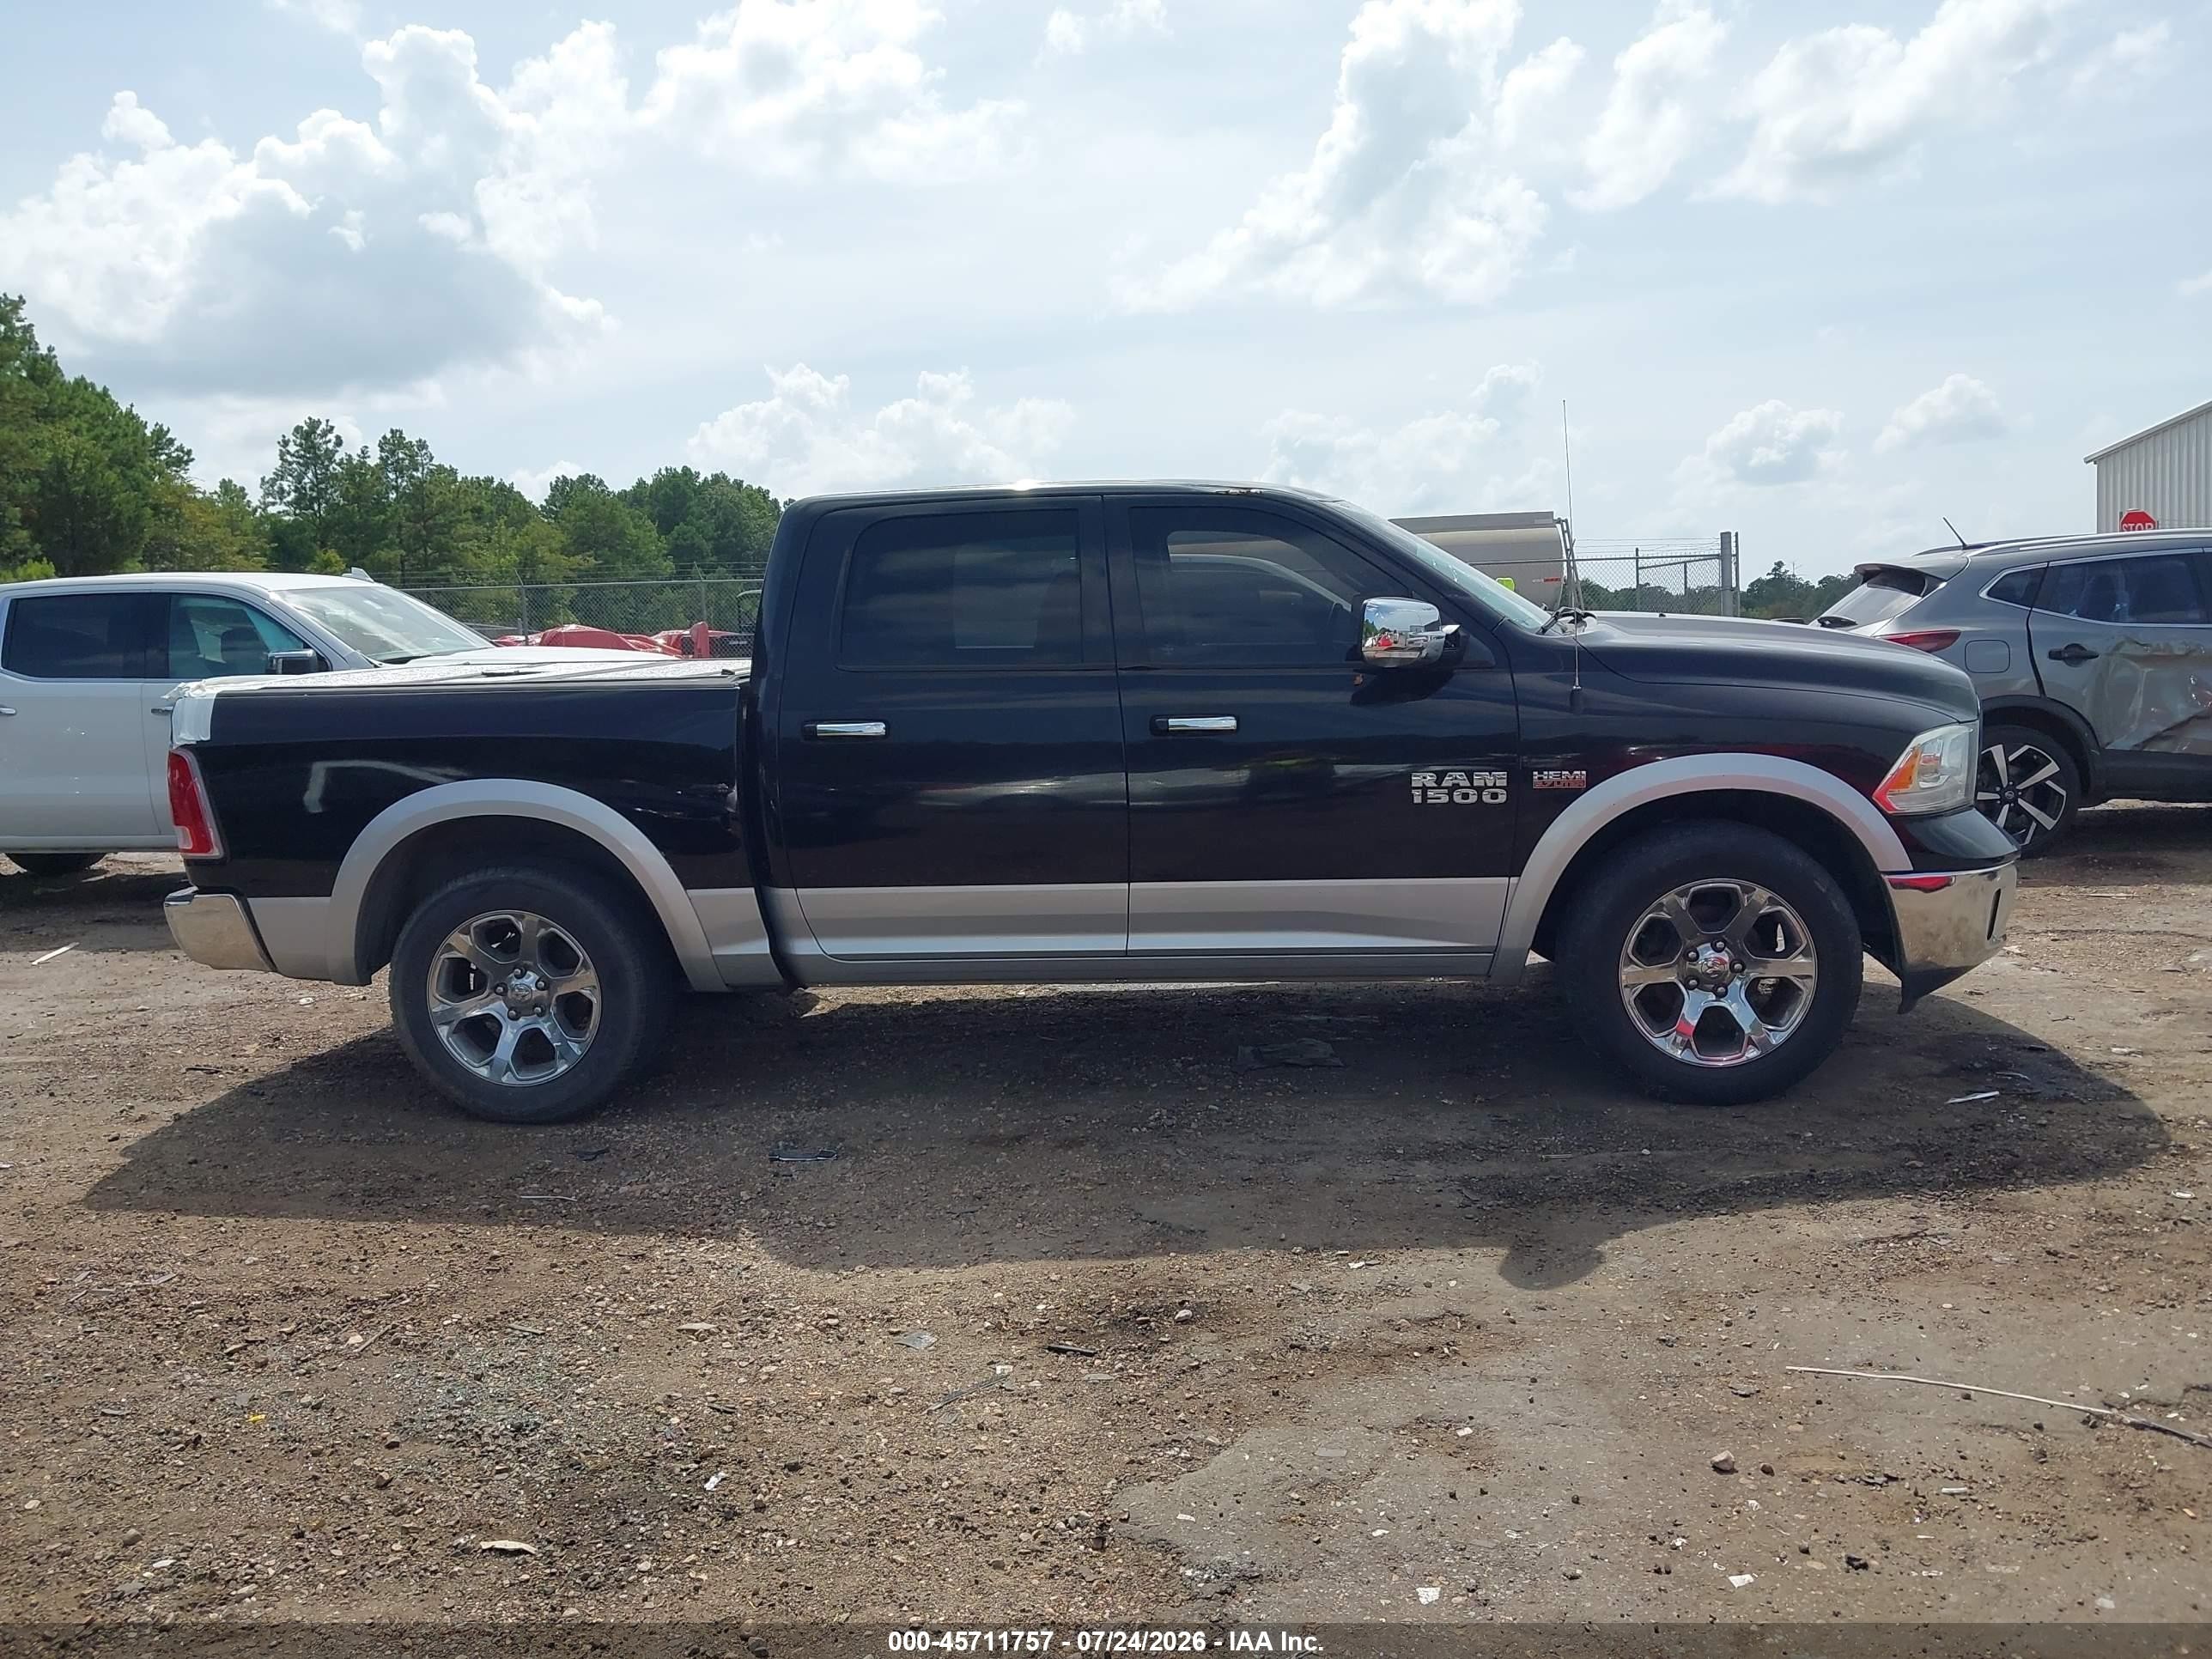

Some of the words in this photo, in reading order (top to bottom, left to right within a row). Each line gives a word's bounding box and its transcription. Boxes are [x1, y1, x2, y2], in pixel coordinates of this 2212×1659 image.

[1411, 771, 1507, 787] RAM
[1533, 770, 1586, 780] HEMI
[1411, 788, 1507, 804] 1500
